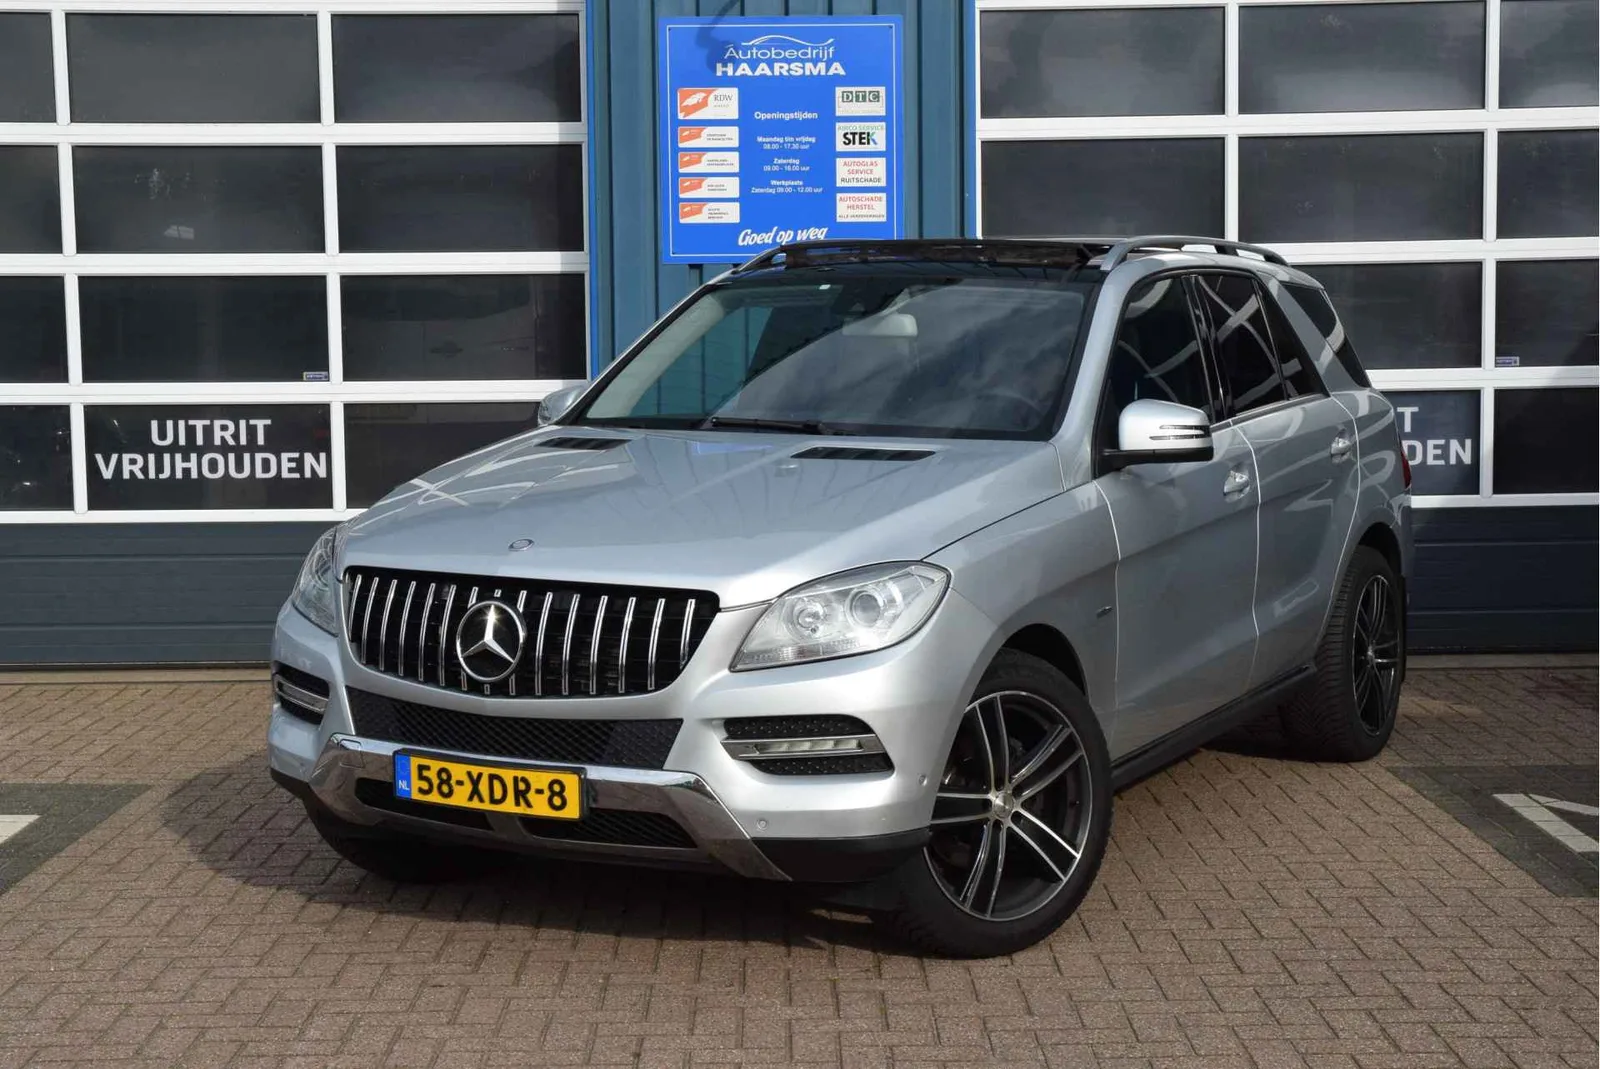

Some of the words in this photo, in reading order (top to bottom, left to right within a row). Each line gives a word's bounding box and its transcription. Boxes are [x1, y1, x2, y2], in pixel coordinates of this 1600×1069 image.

[724, 45, 835, 61] Autobedrijf
[715, 62, 846, 77] HAARSMA
[713, 94, 733, 102] RDW
[842, 90, 880, 103] DTC
[754, 110, 818, 121] Openingstijden
[795, 135, 816, 143] vrijdag
[842, 131, 878, 146] STEK
[773, 157, 800, 165] Zaterdag
[738, 226, 778, 246] Goed
[775, 230, 794, 246] op
[150, 418, 272, 446] UITRIT
[94, 451, 327, 480] VRIJHOUDEN
[398, 780, 410, 791] NL
[416, 763, 568, 812] 58-XDR-8
